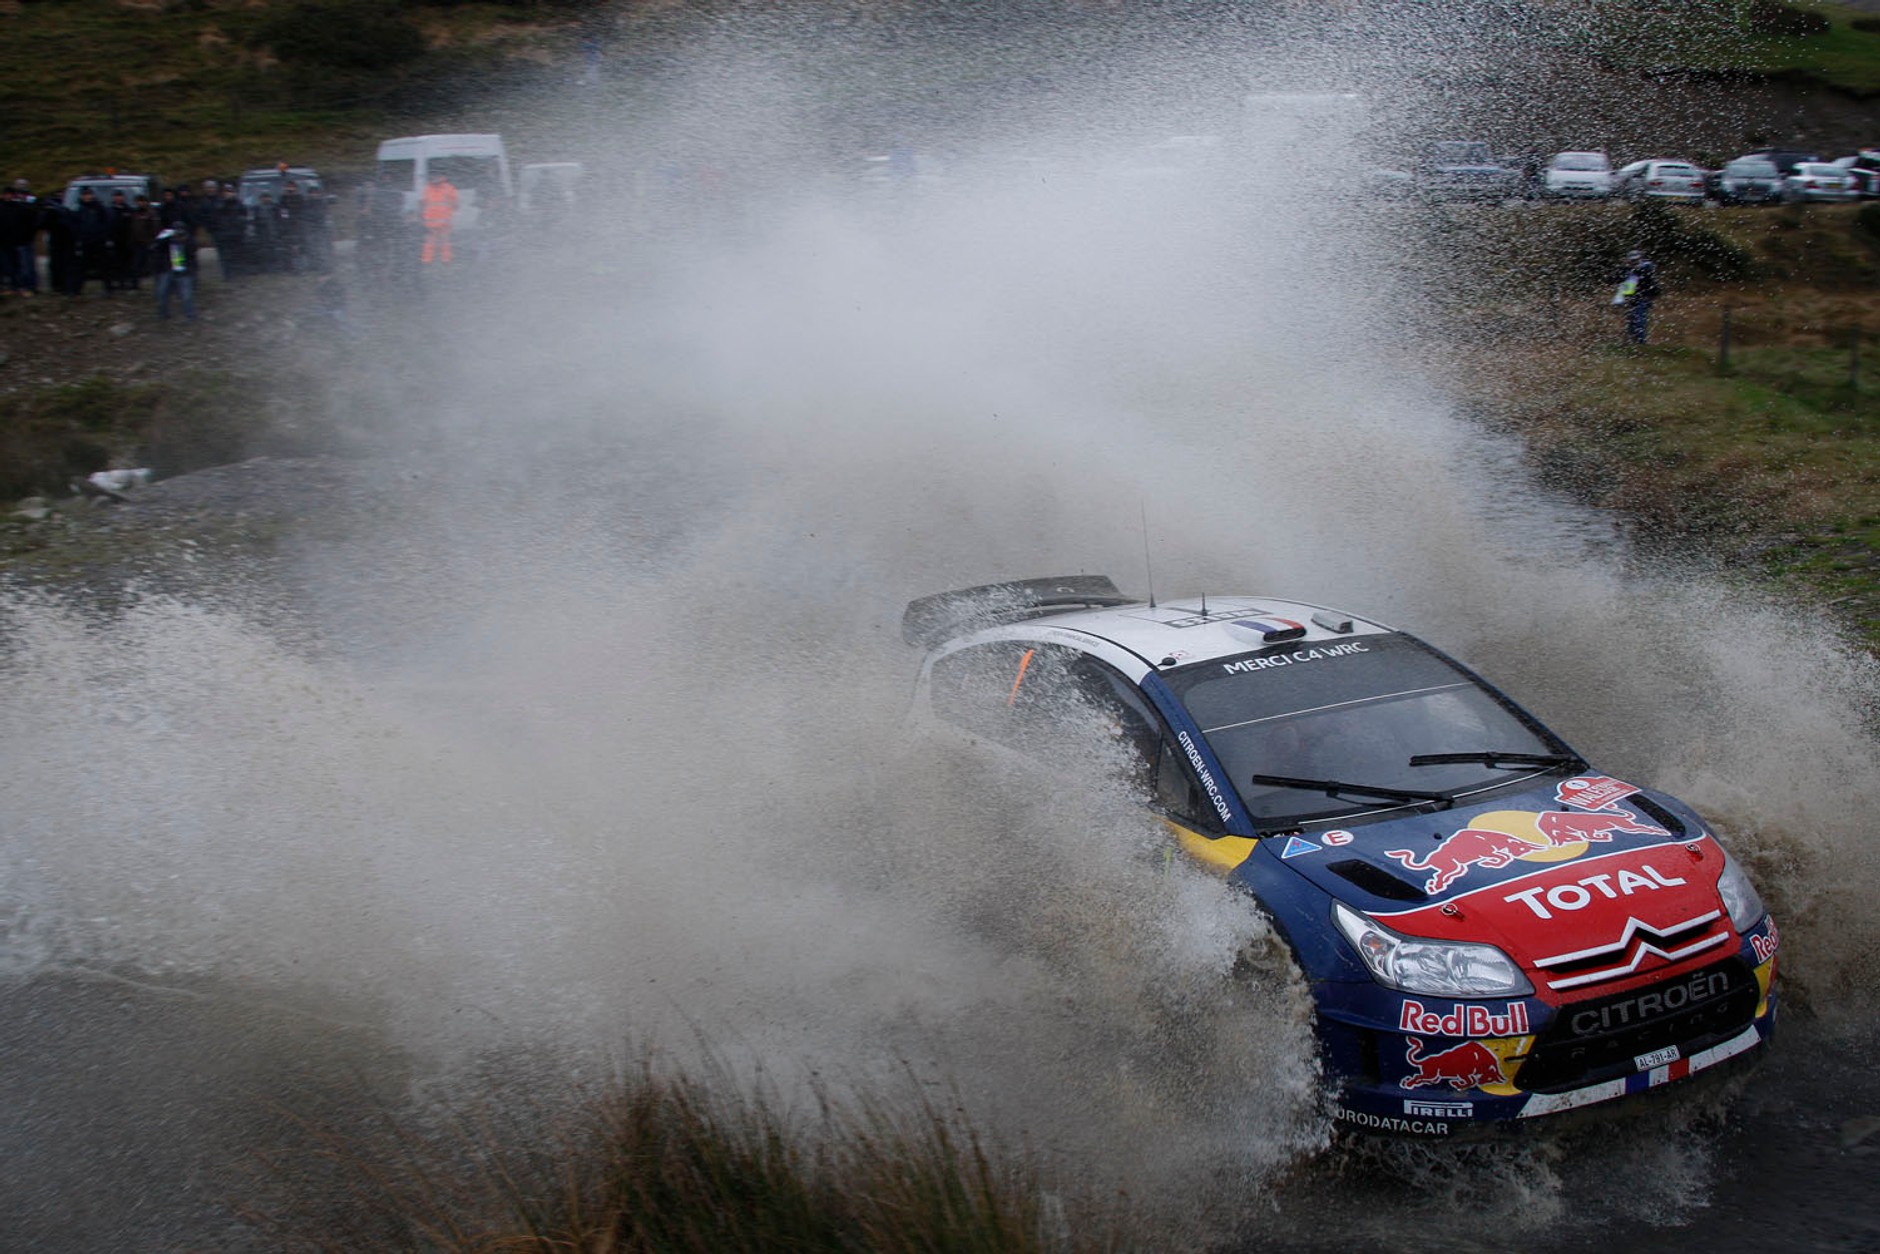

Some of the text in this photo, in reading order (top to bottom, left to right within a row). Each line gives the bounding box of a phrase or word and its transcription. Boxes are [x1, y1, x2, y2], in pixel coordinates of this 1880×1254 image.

[1223, 641, 1370, 675] MERCI C4 WRC
[1178, 730, 1232, 823] CITROEN-WRC.COM
[1326, 831, 1348, 845] E
[1503, 865, 1687, 919] TOTAL
[1399, 1000, 1530, 1037] Red Bull
[1638, 1048, 1678, 1068] AL-791-AR
[1335, 1109, 1448, 1134] URODATACAR
[1403, 1100, 1473, 1117] PIRELLI
